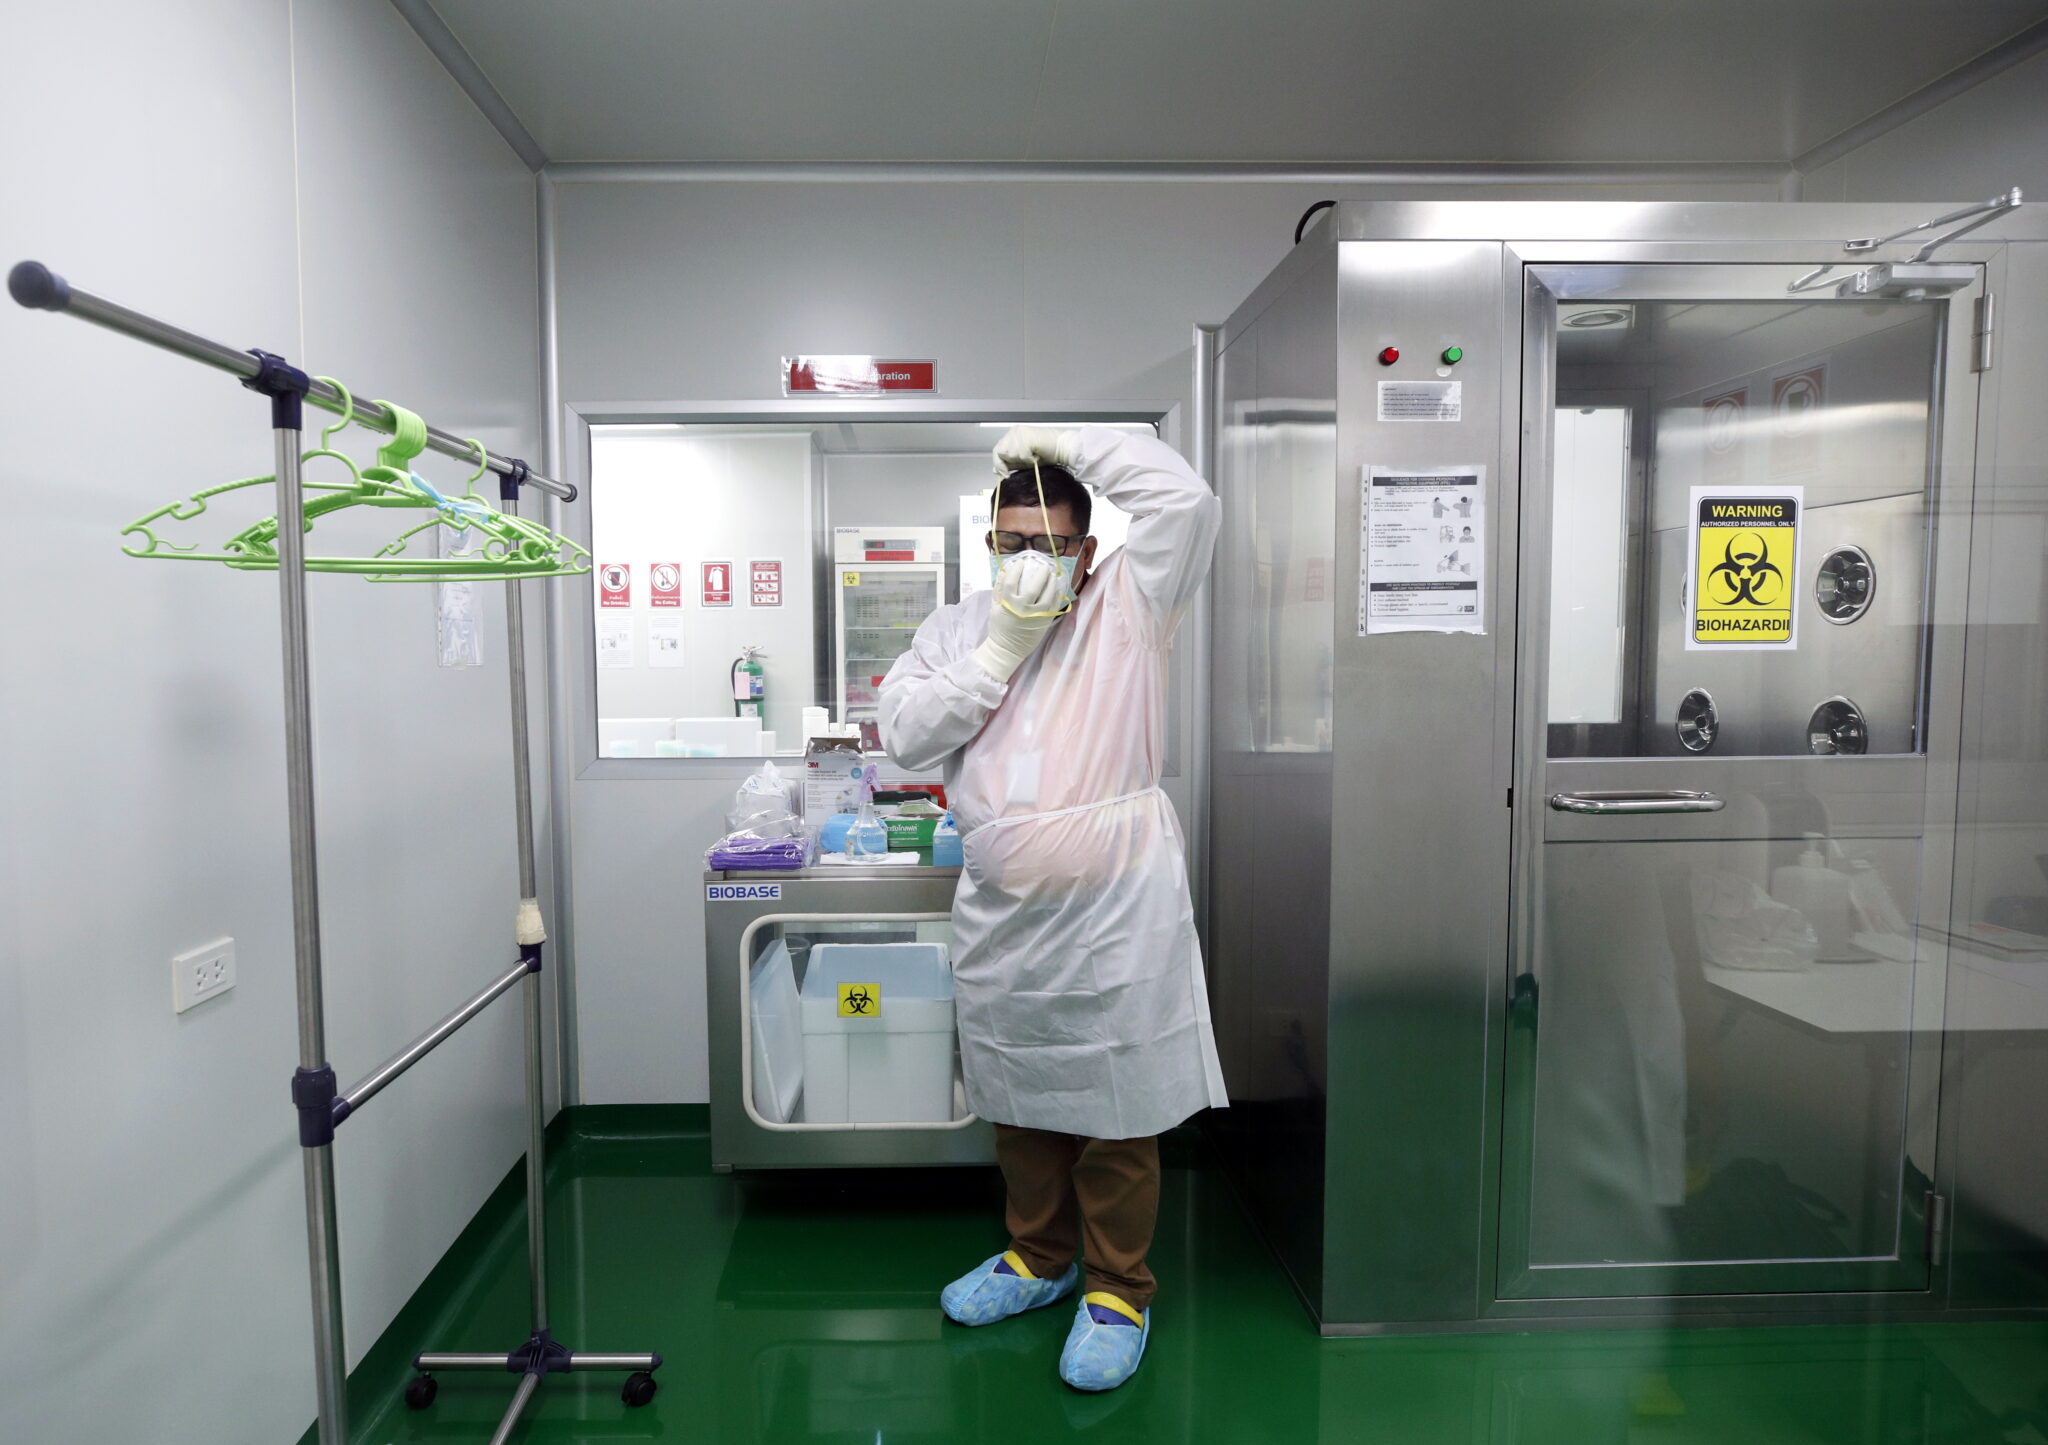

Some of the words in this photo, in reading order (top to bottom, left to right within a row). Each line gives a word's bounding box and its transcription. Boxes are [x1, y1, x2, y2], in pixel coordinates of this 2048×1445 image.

[876, 372, 911, 381] aration
[1712, 505, 1783, 518] WARNING
[972, 515, 990, 524] BIO
[708, 886, 779, 899] BIOBASE
